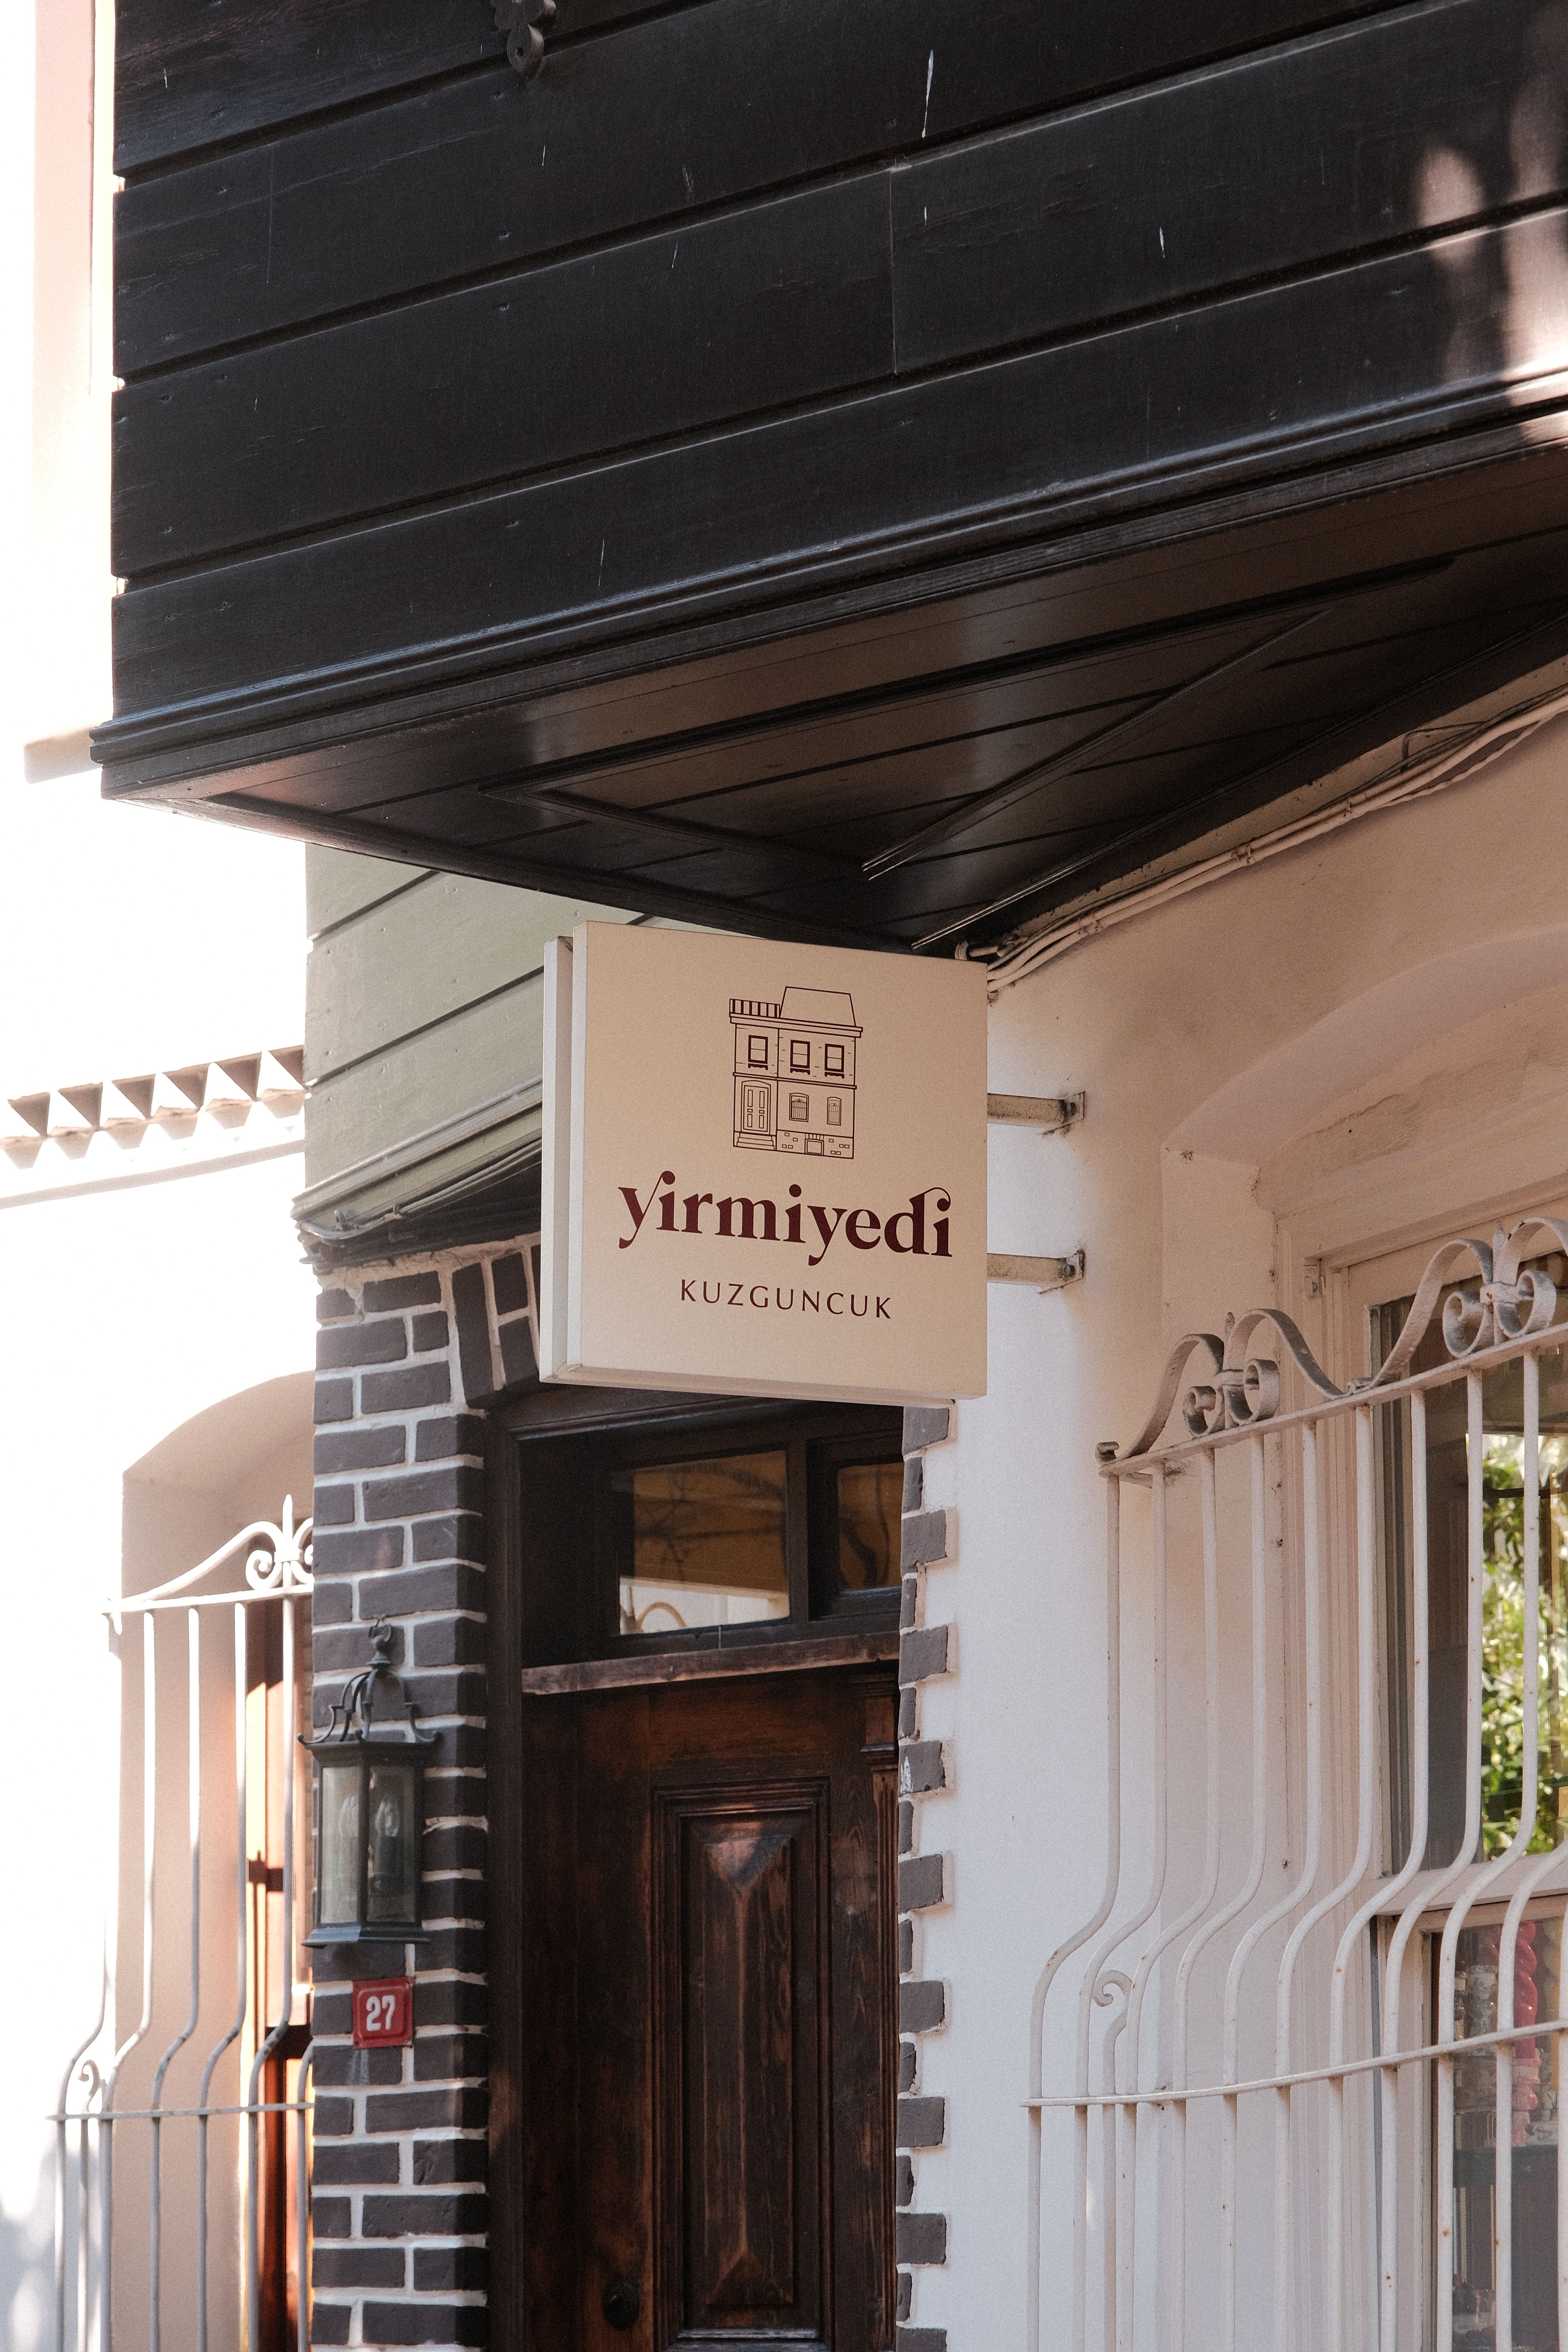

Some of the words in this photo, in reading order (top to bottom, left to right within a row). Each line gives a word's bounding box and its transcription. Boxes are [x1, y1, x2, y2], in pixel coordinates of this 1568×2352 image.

[618, 1170, 952, 1266] yirmiyedi
[681, 1279, 891, 1319] KUZGUNCUK
[366, 1995, 396, 2032] 27
